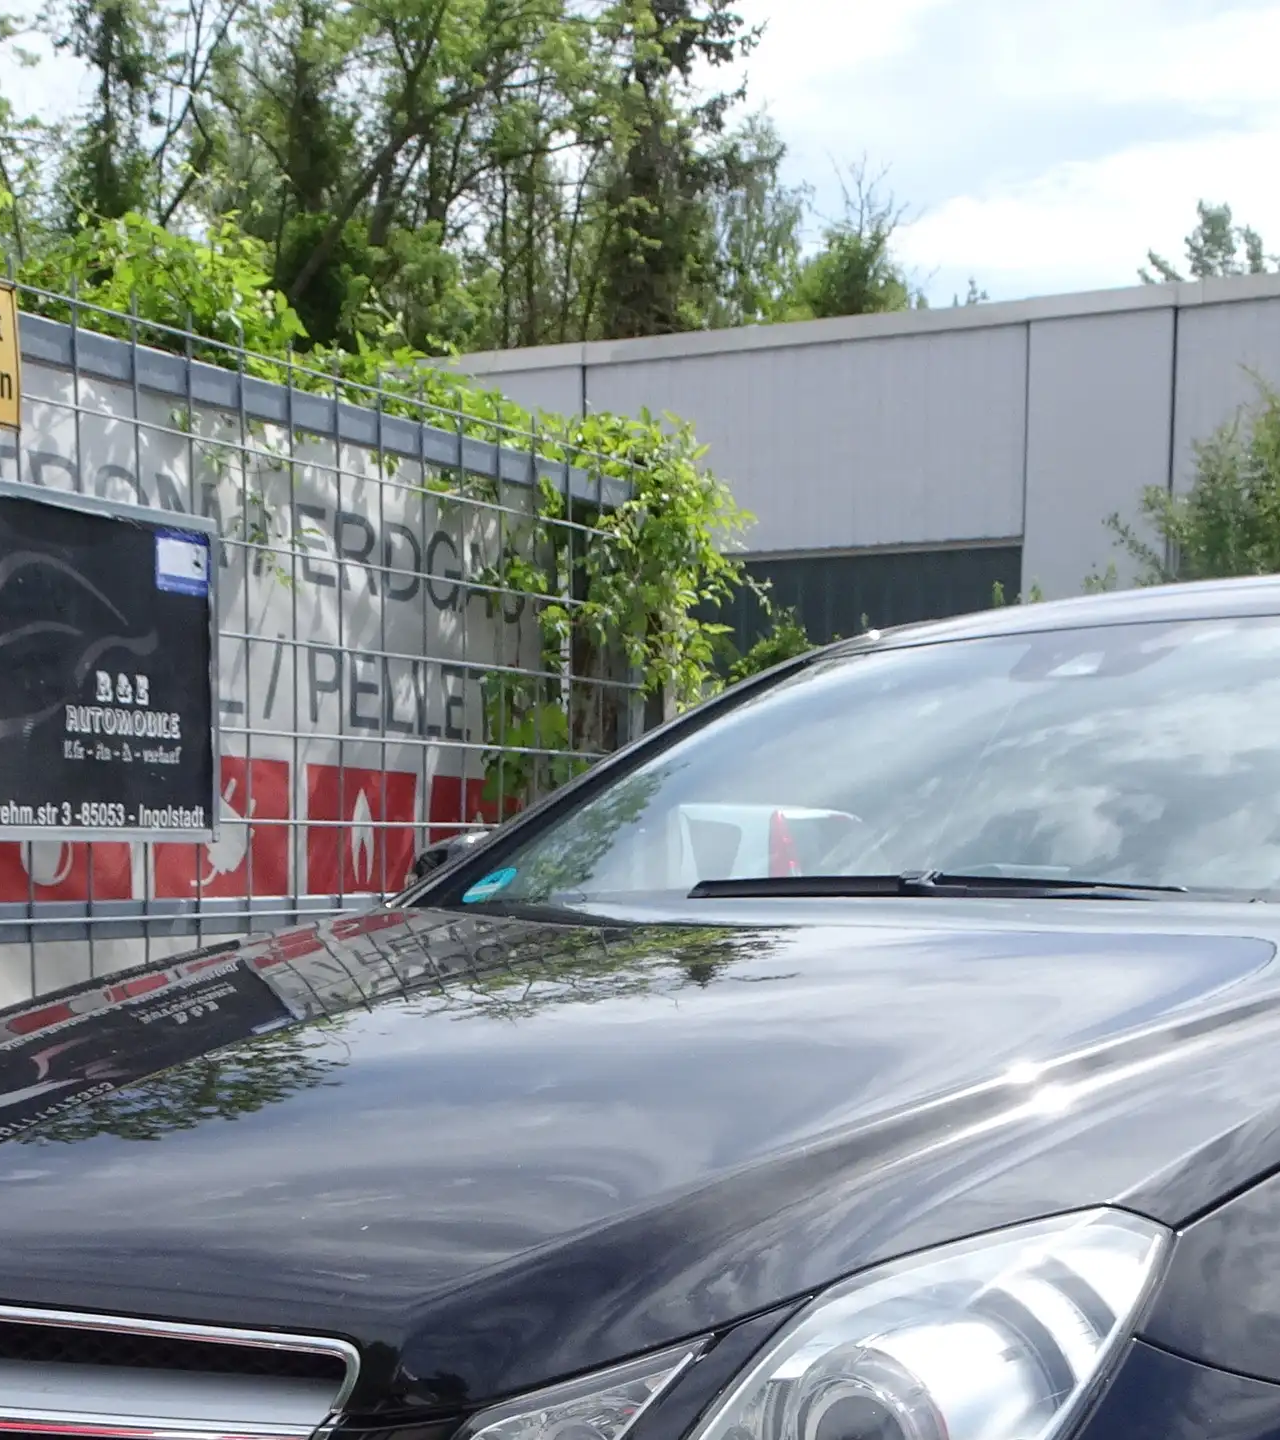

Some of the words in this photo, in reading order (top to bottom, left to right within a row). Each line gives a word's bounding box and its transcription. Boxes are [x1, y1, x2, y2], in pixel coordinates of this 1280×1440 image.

[65, 704, 181, 739] AUTOMOBILE
[61, 802, 71, 825] 3
[139, 804, 205, 828] Ingolstadt
